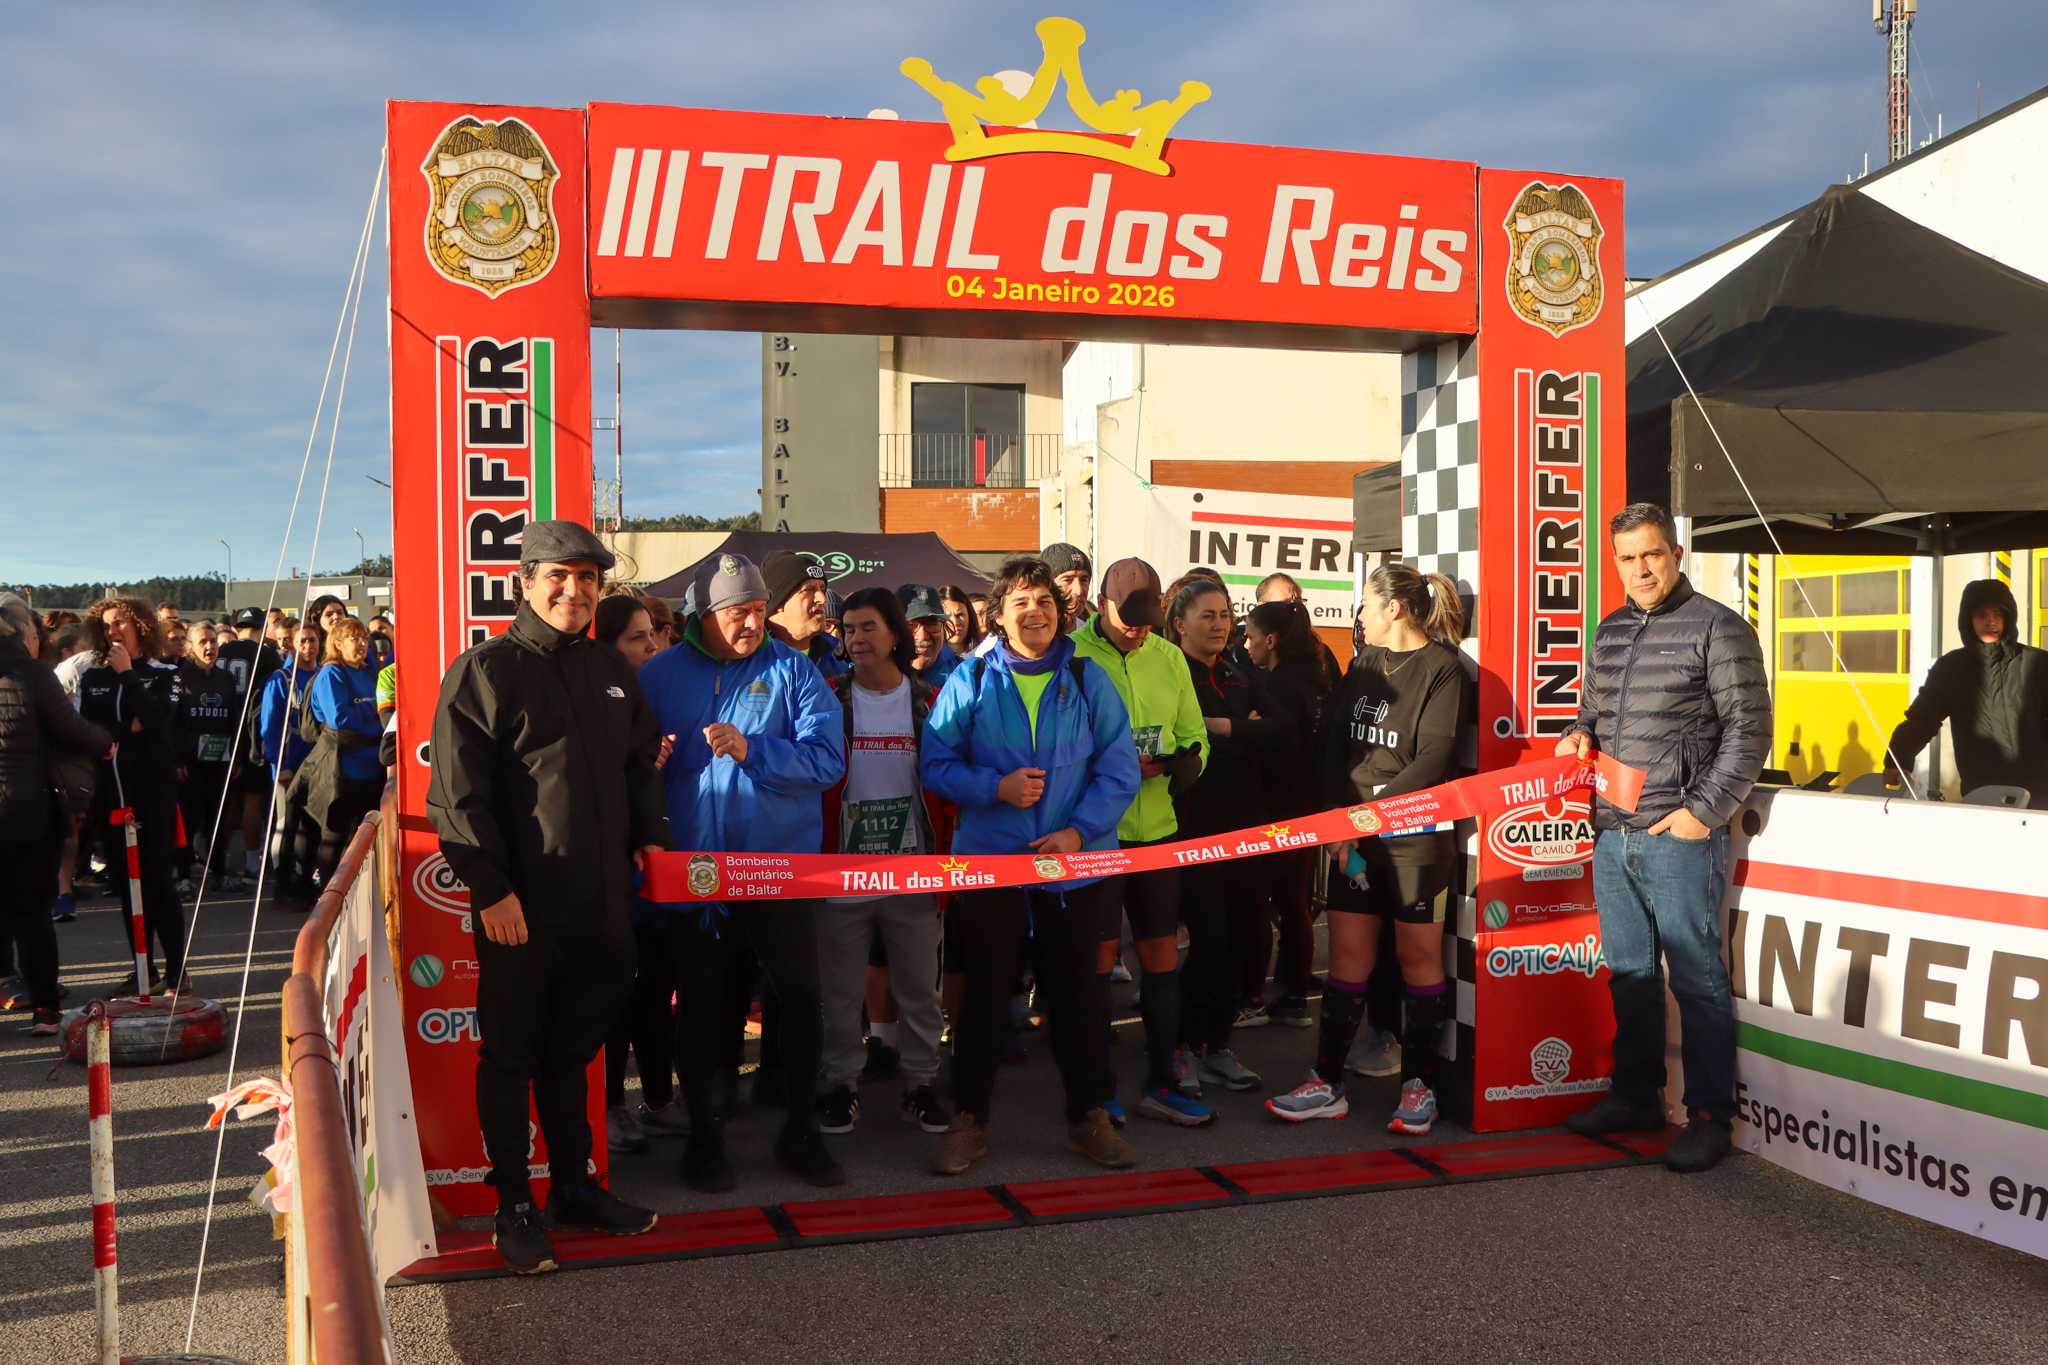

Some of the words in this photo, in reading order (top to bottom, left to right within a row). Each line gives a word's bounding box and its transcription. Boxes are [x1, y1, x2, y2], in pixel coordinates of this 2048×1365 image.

[457, 153, 523, 174] BALTAR
[450, 176, 476, 208] CORPO
[480, 172, 535, 210] BOMBEIROS
[597, 148, 690, 257] III
[701, 151, 1000, 270] TRAIL
[1041, 173, 1228, 280] dos
[1260, 185, 1467, 292] Reis
[1530, 214, 1579, 233] BALTAR
[458, 235, 526, 257] VOLUNTÁRIOS
[1525, 232, 1544, 259] CORPO
[1547, 230, 1587, 264] BOMBEIROS
[946, 274, 985, 298] 04
[992, 277, 1099, 303] Janeiro
[1108, 283, 1175, 308] 2026
[1531, 284, 1581, 303] VOLUNTÁRIOS
[773, 418, 790, 532] BALTA
[466, 338, 528, 648] ERFER
[1189, 530, 1402, 573] INTER
[1535, 371, 1580, 735] INTERFER
[1314, 606, 1342, 618] em
[864, 741, 885, 749] TRAIL
[888, 742, 902, 750] dos
[1500, 777, 1549, 805] TRAIL
[1553, 774, 1576, 795] dos
[1576, 766, 1609, 793] Reis
[1377, 793, 1433, 810] Bombeiros
[1382, 802, 1440, 818] Voluntários
[861, 816, 899, 832] 1112
[1390, 820, 1404, 829] de
[1404, 814, 1434, 826] Baltar
[1505, 822, 1595, 843] CALEIRA
[1173, 845, 1232, 863] TRAIL
[1235, 841, 1271, 855] dos
[1274, 831, 1318, 848] Reis
[1534, 844, 1574, 855] CAMILO
[726, 856, 790, 867] Bombeiros
[1065, 852, 1125, 862] Bombeiros
[1069, 859, 1132, 870] Voluntários
[727, 870, 794, 881] Voluntários
[1091, 866, 1124, 875] Baltar
[1525, 870, 1542, 878] SEM
[1543, 867, 1582, 877] EMENDAS
[727, 886, 743, 896] de
[747, 884, 783, 896] Baltar
[840, 871, 900, 891] TRAIL
[906, 871, 944, 889] dos
[950, 870, 995, 887] Reis
[1534, 1060, 1567, 1071] SVA
[1514, 1087, 1545, 1096] Serviços
[1546, 1084, 1577, 1093] Viaturas
[1577, 1082, 1594, 1090] Auto
[1735, 1081, 1971, 1198] Especialistas
